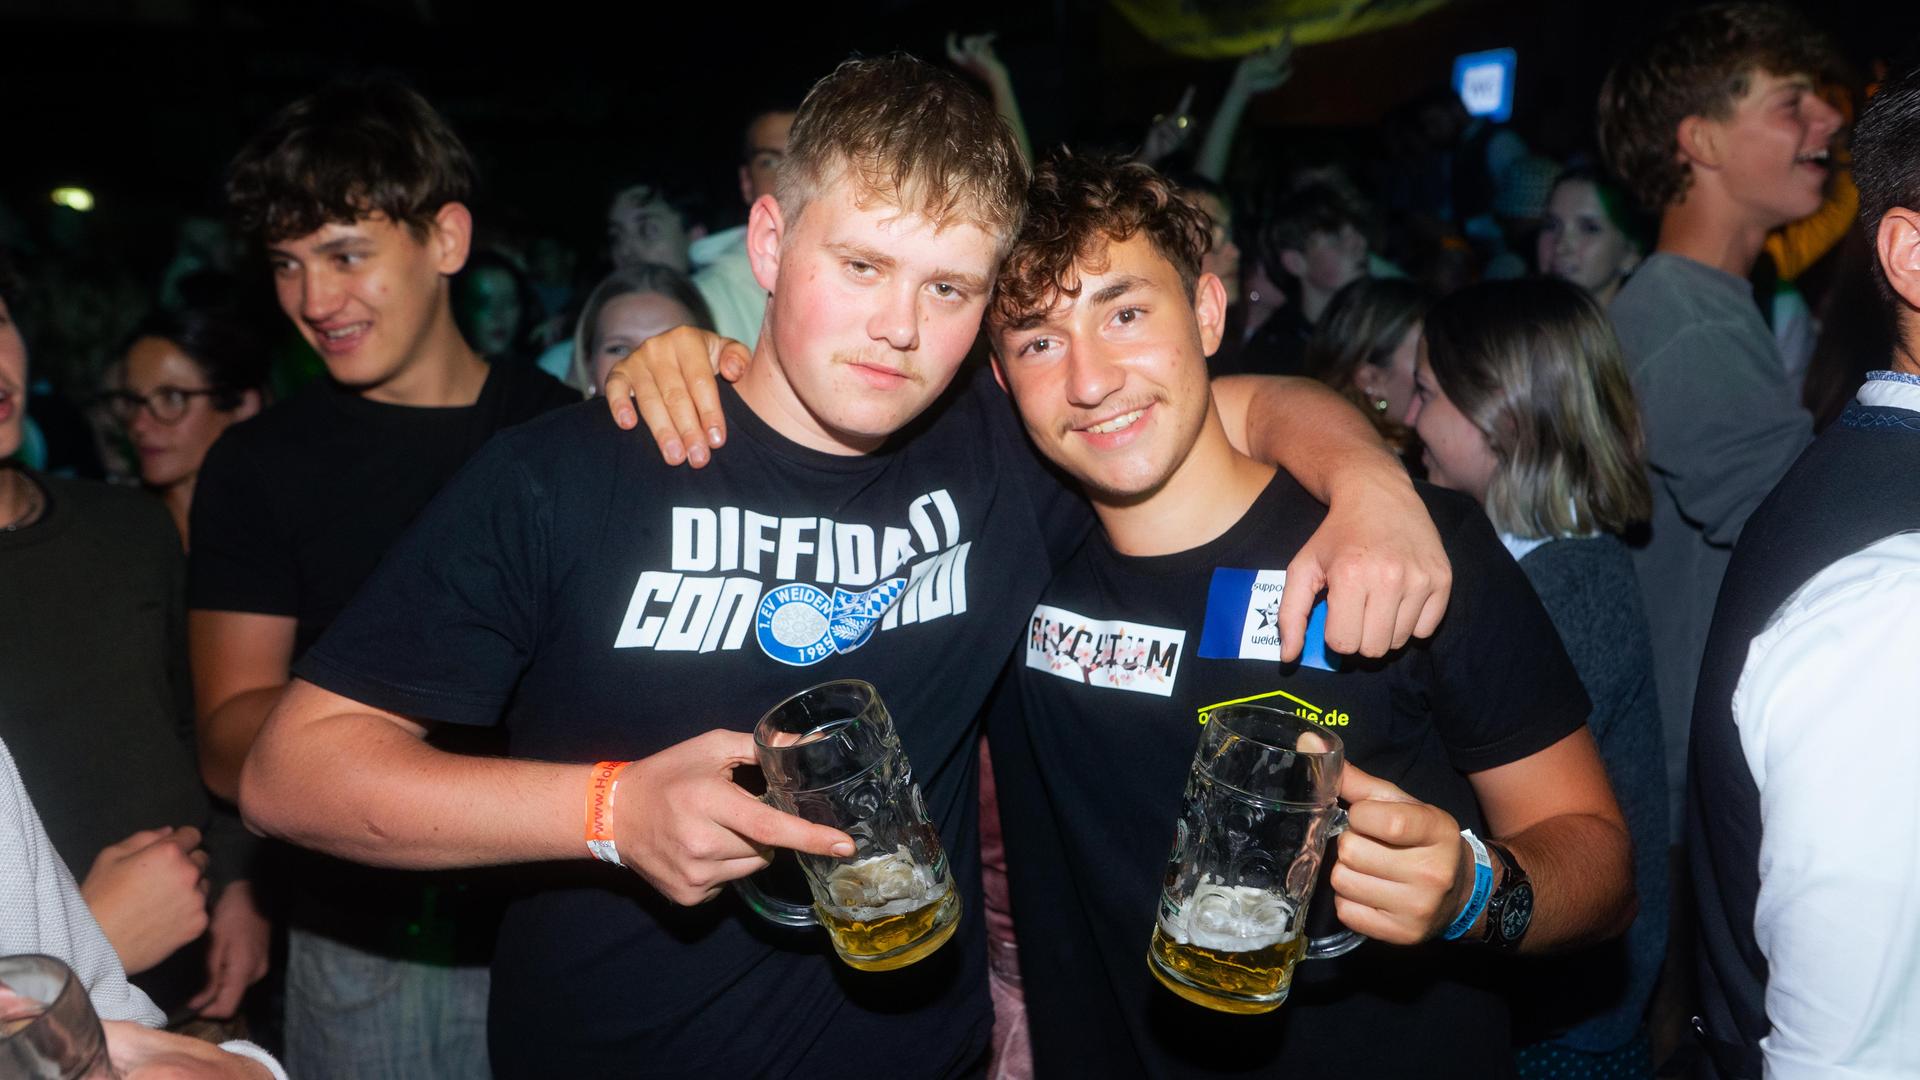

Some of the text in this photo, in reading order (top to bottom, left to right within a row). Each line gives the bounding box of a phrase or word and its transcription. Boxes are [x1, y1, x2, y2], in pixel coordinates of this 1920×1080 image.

[1253, 582, 1284, 593] suppo
[613, 571, 763, 654] CON
[761, 599, 777, 619] EV
[776, 588, 832, 615] WEIDEN
[797, 637, 834, 662] 1985
